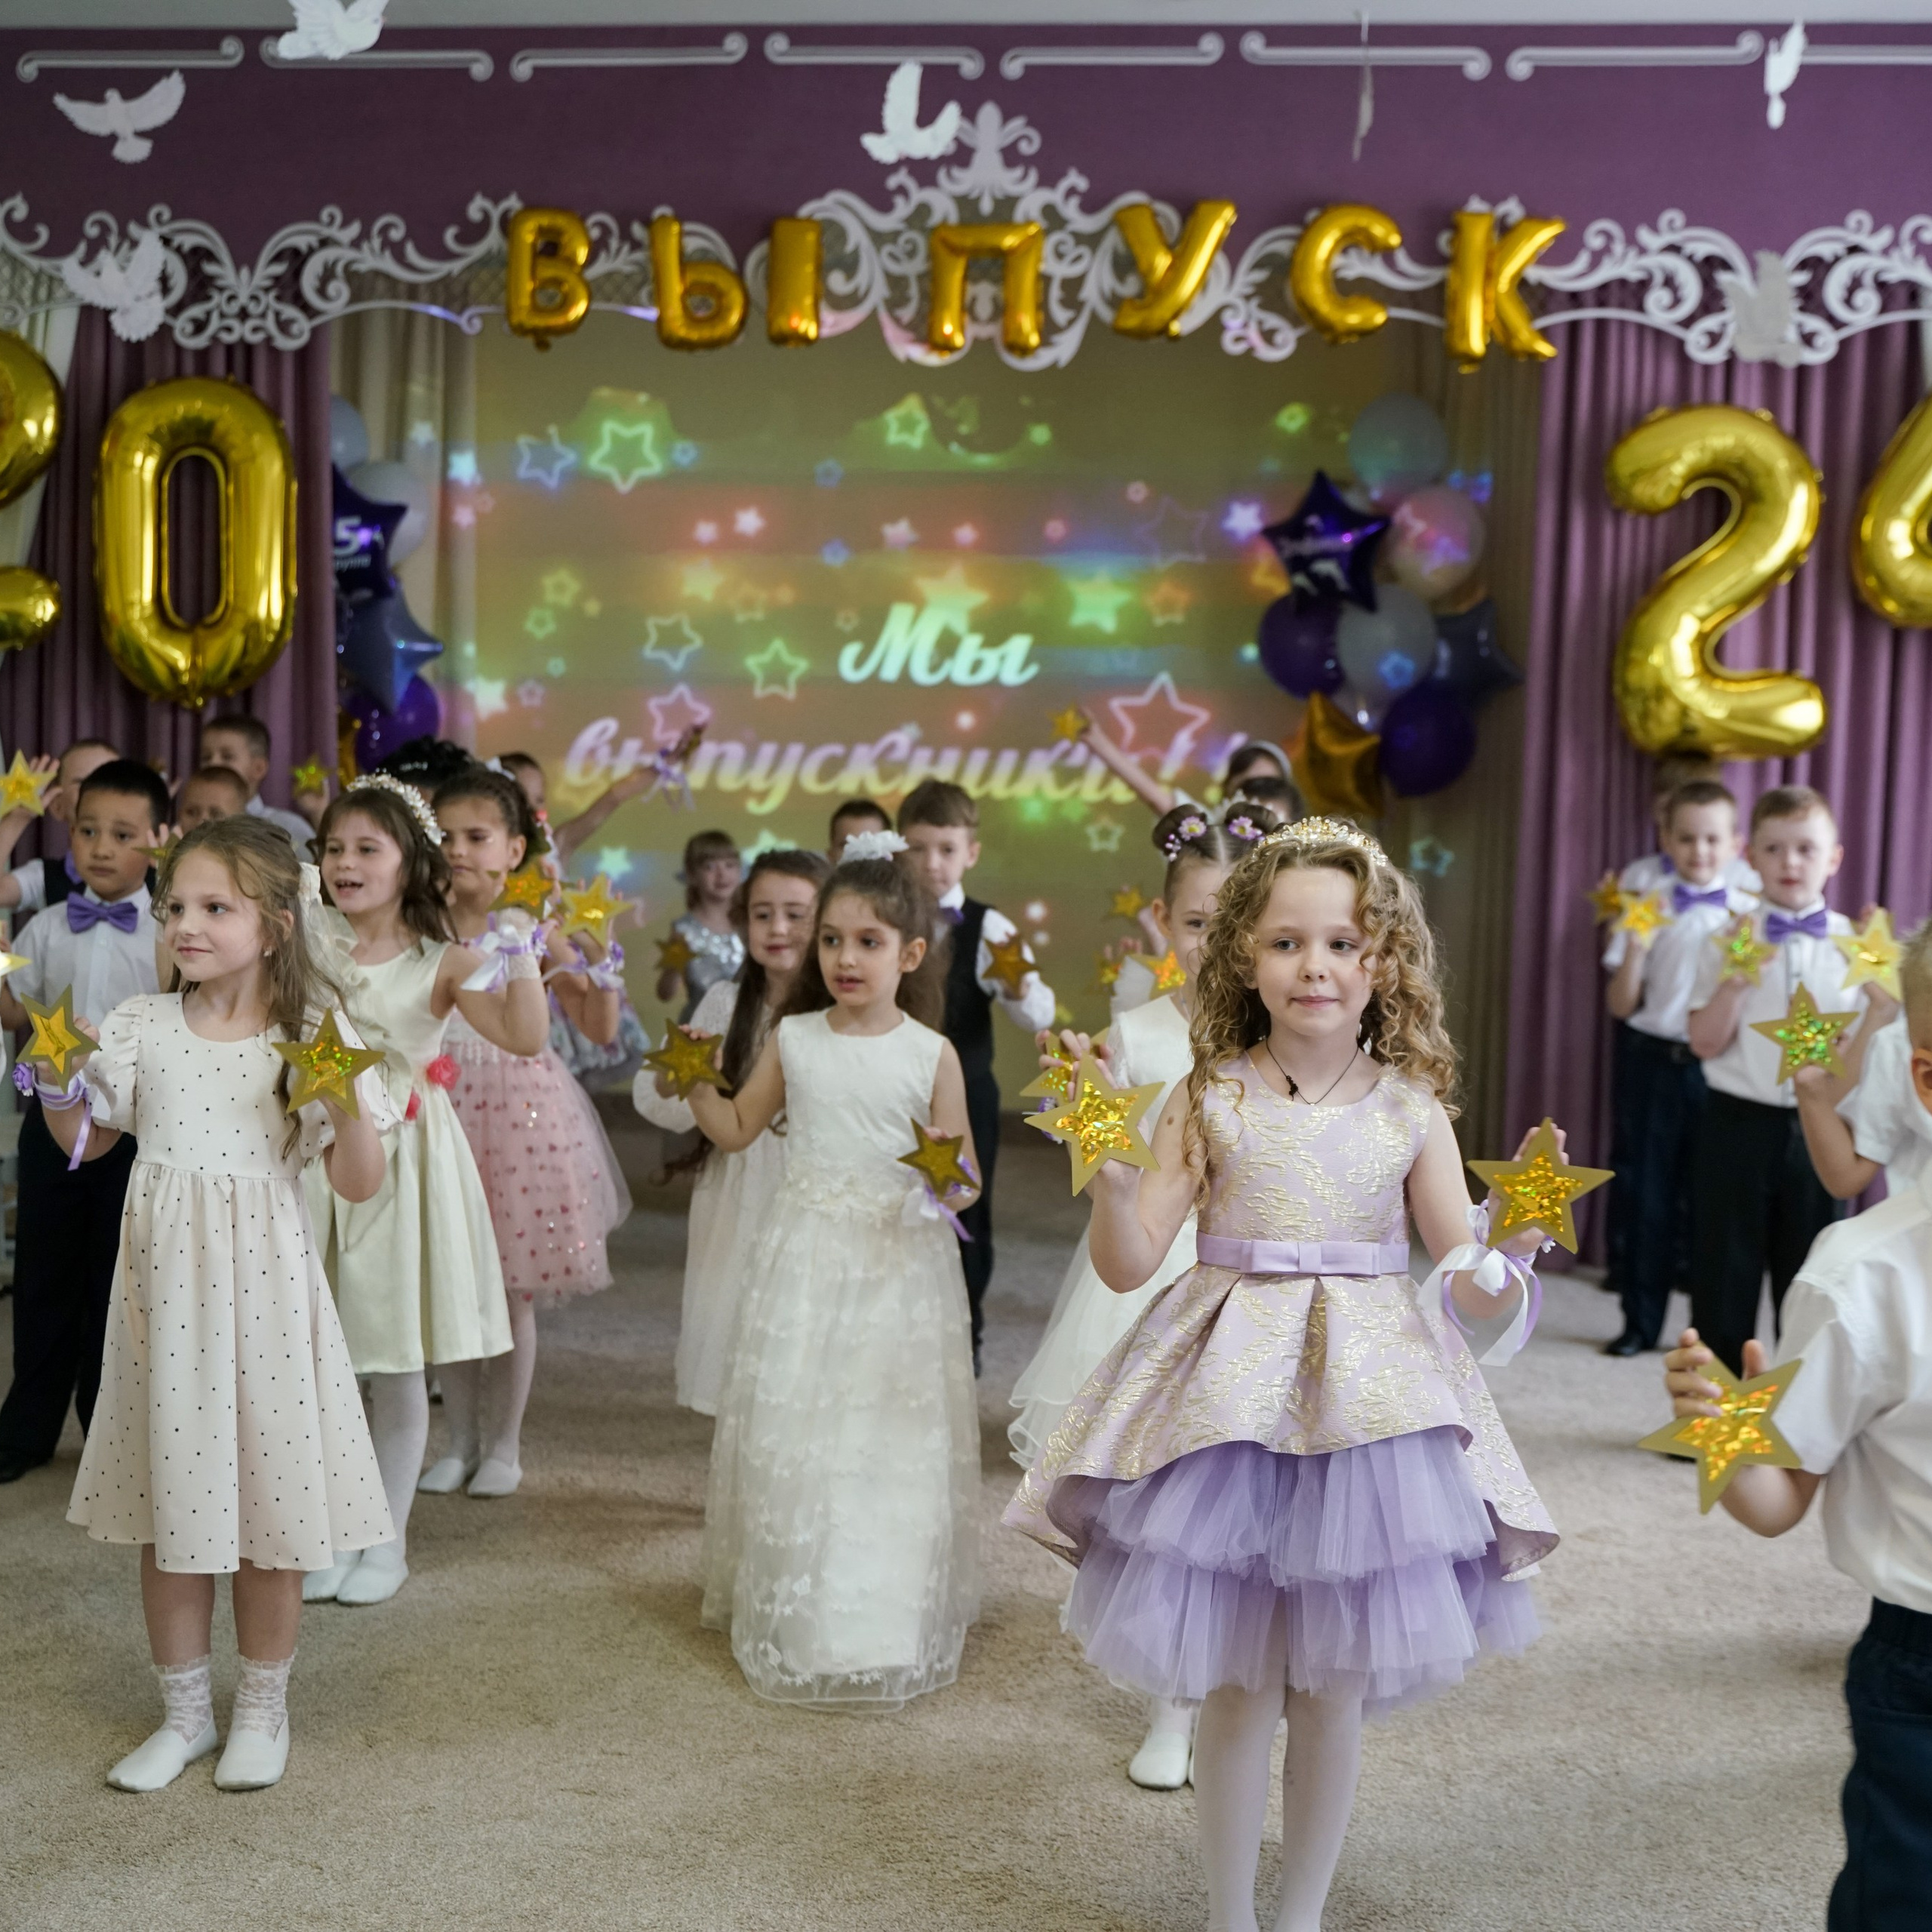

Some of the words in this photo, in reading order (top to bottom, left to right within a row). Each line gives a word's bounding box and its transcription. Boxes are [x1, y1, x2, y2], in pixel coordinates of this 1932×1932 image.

[507, 200, 1565, 371] ВЫПУСК
[0, 328, 297, 708] 0
[838, 603, 1039, 687] Мы
